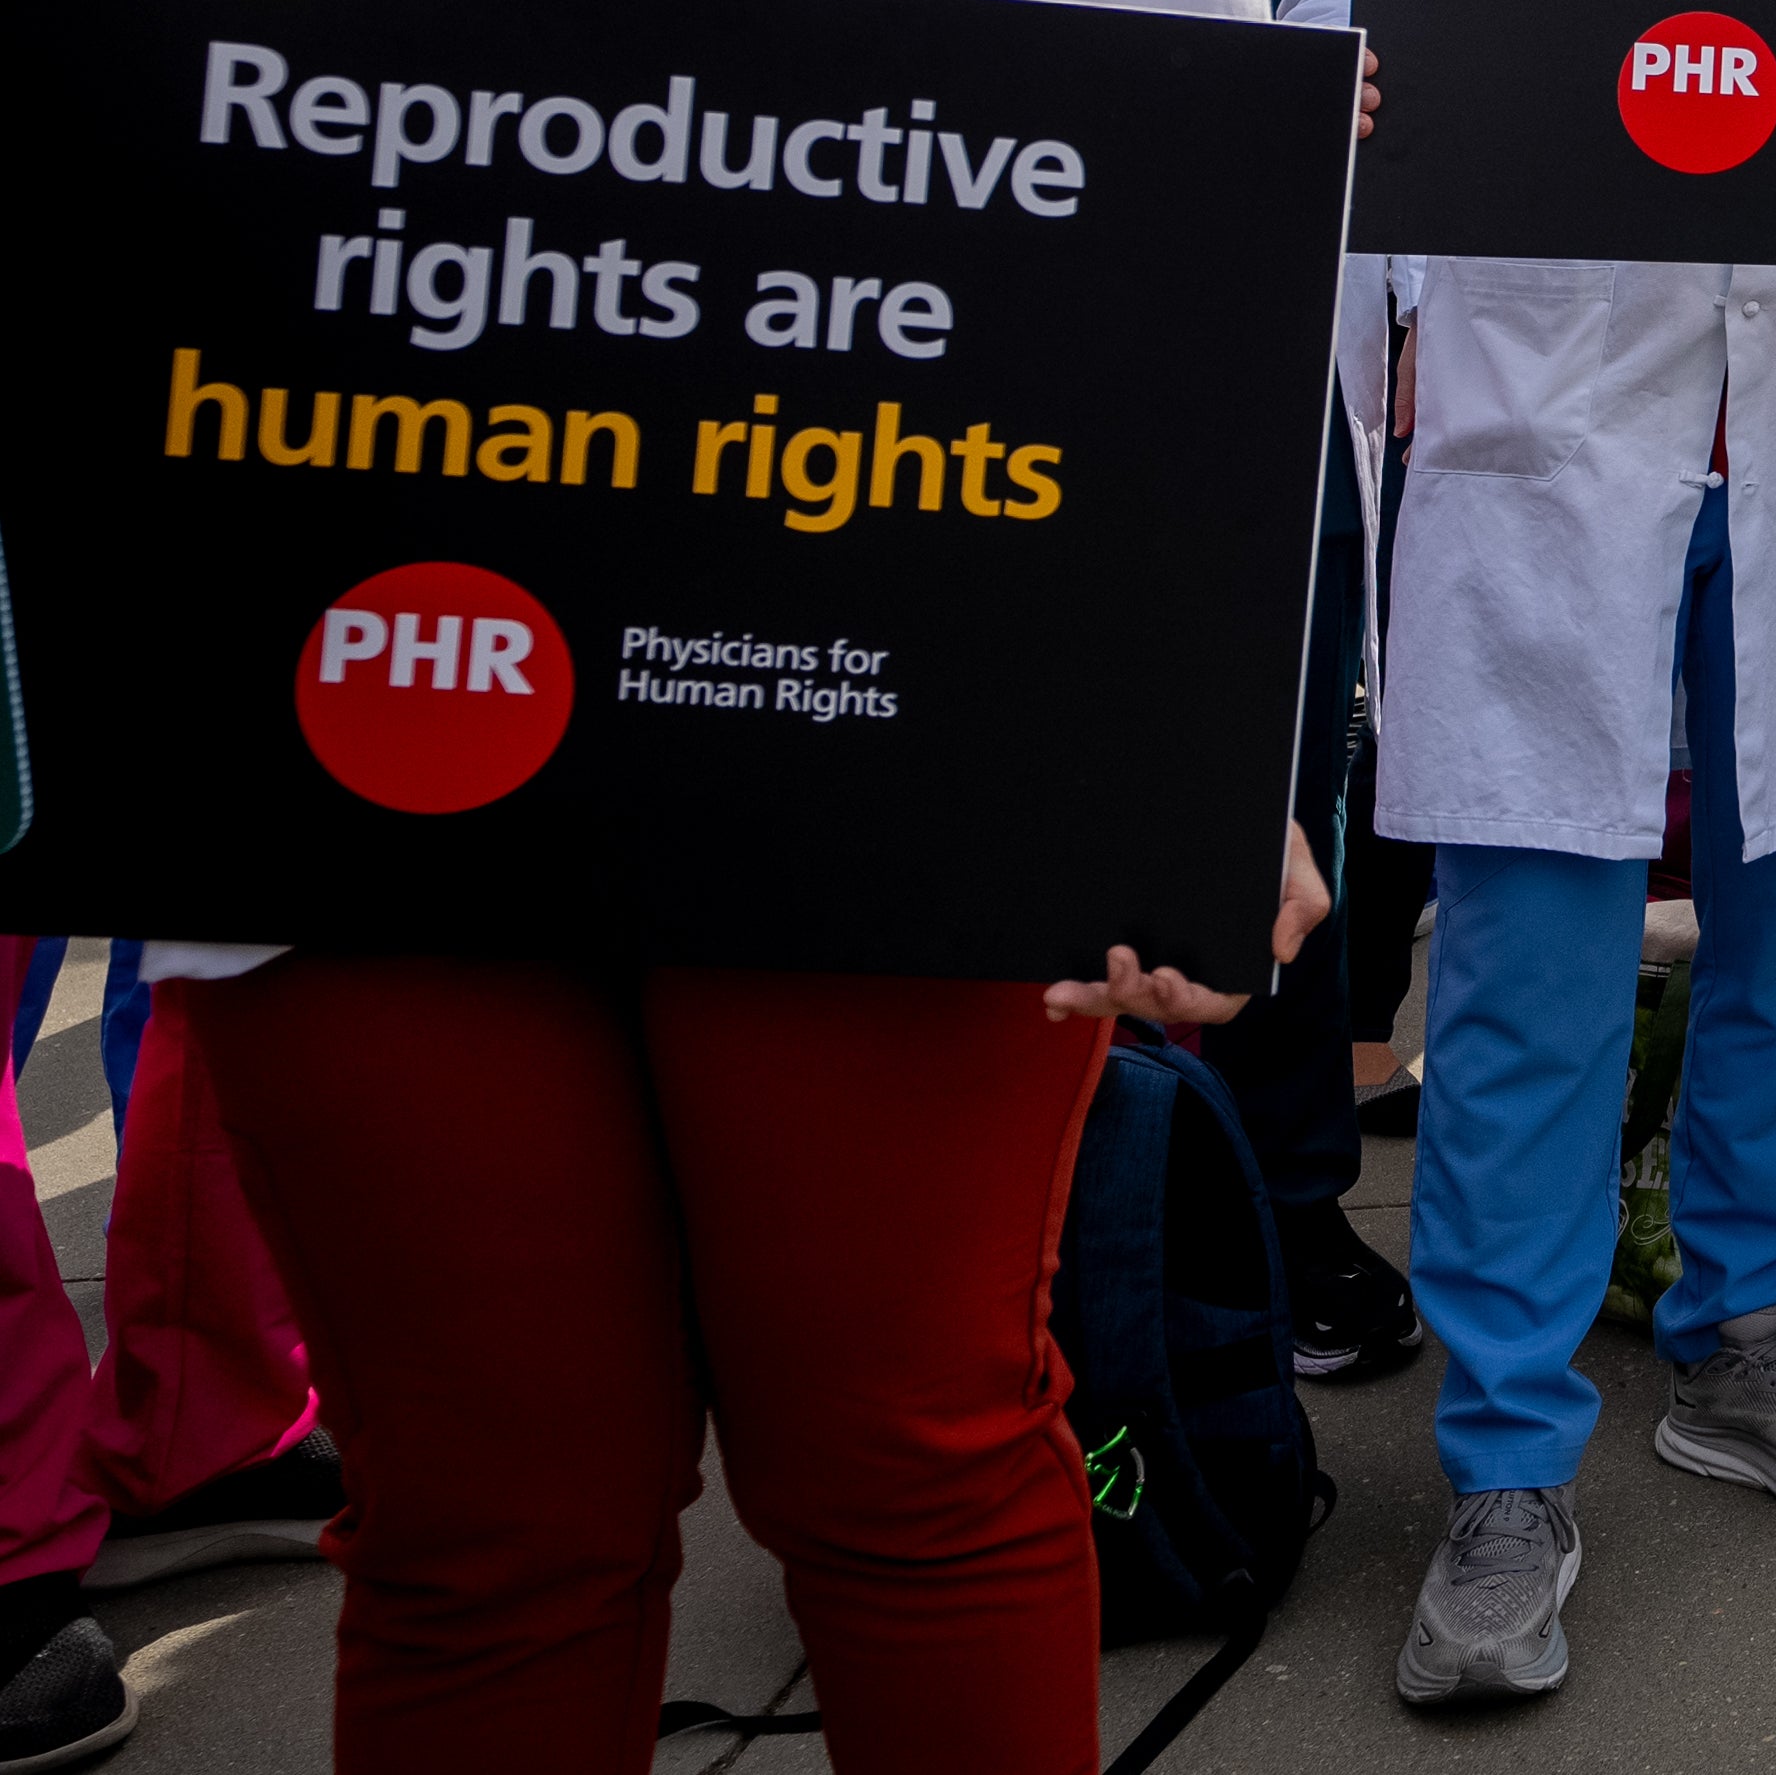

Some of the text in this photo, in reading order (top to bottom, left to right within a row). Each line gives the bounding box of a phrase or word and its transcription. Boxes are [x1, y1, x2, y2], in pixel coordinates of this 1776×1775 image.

[1631, 42, 1759, 96] PHR
[200, 41, 1085, 218] Reproductive
[312, 208, 955, 361] rights are
[164, 347, 1064, 534] human rights
[317, 607, 535, 695] PHR
[621, 626, 887, 675] Physicians for
[618, 669, 897, 723] Human Rights
